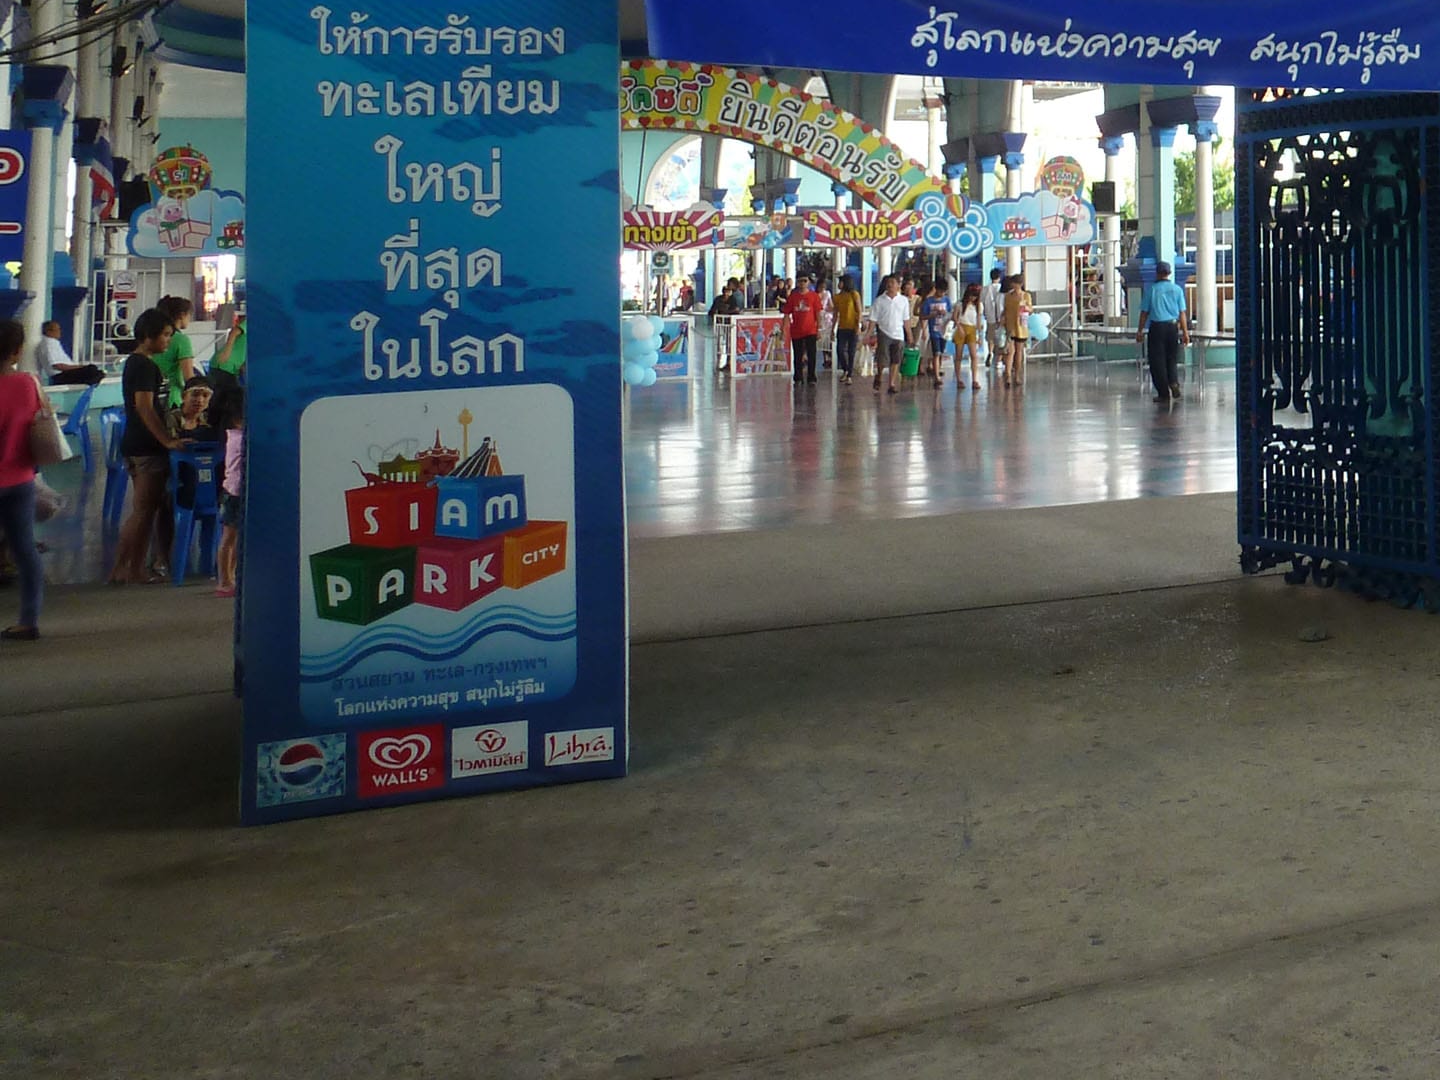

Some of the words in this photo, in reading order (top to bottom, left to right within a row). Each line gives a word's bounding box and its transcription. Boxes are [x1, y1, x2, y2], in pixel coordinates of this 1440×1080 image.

[310, 5, 565, 55] ให้การรับรอง
[911, 6, 1222, 79] สู่โลกแห่งความสุข
[1250, 27, 1422, 84] สนุกไม่รู้ลืม
[317, 64, 561, 117] ทะเลเทียม
[718, 79, 910, 205] ยินดีต้อนรับ
[374, 134, 502, 217] ใหญ่
[624, 219, 699, 244] ทางเข้า
[809, 212, 818, 224] 5
[829, 219, 898, 241] ทางเข้า
[908, 212, 919, 223] 6
[379, 218, 502, 309] ที่สุด
[350, 307, 525, 381] ในโลก
[362, 492, 519, 535] SIAM
[326, 552, 496, 607] PARK
[521, 543, 561, 565] CITY
[372, 769, 430, 787] WALL'S
